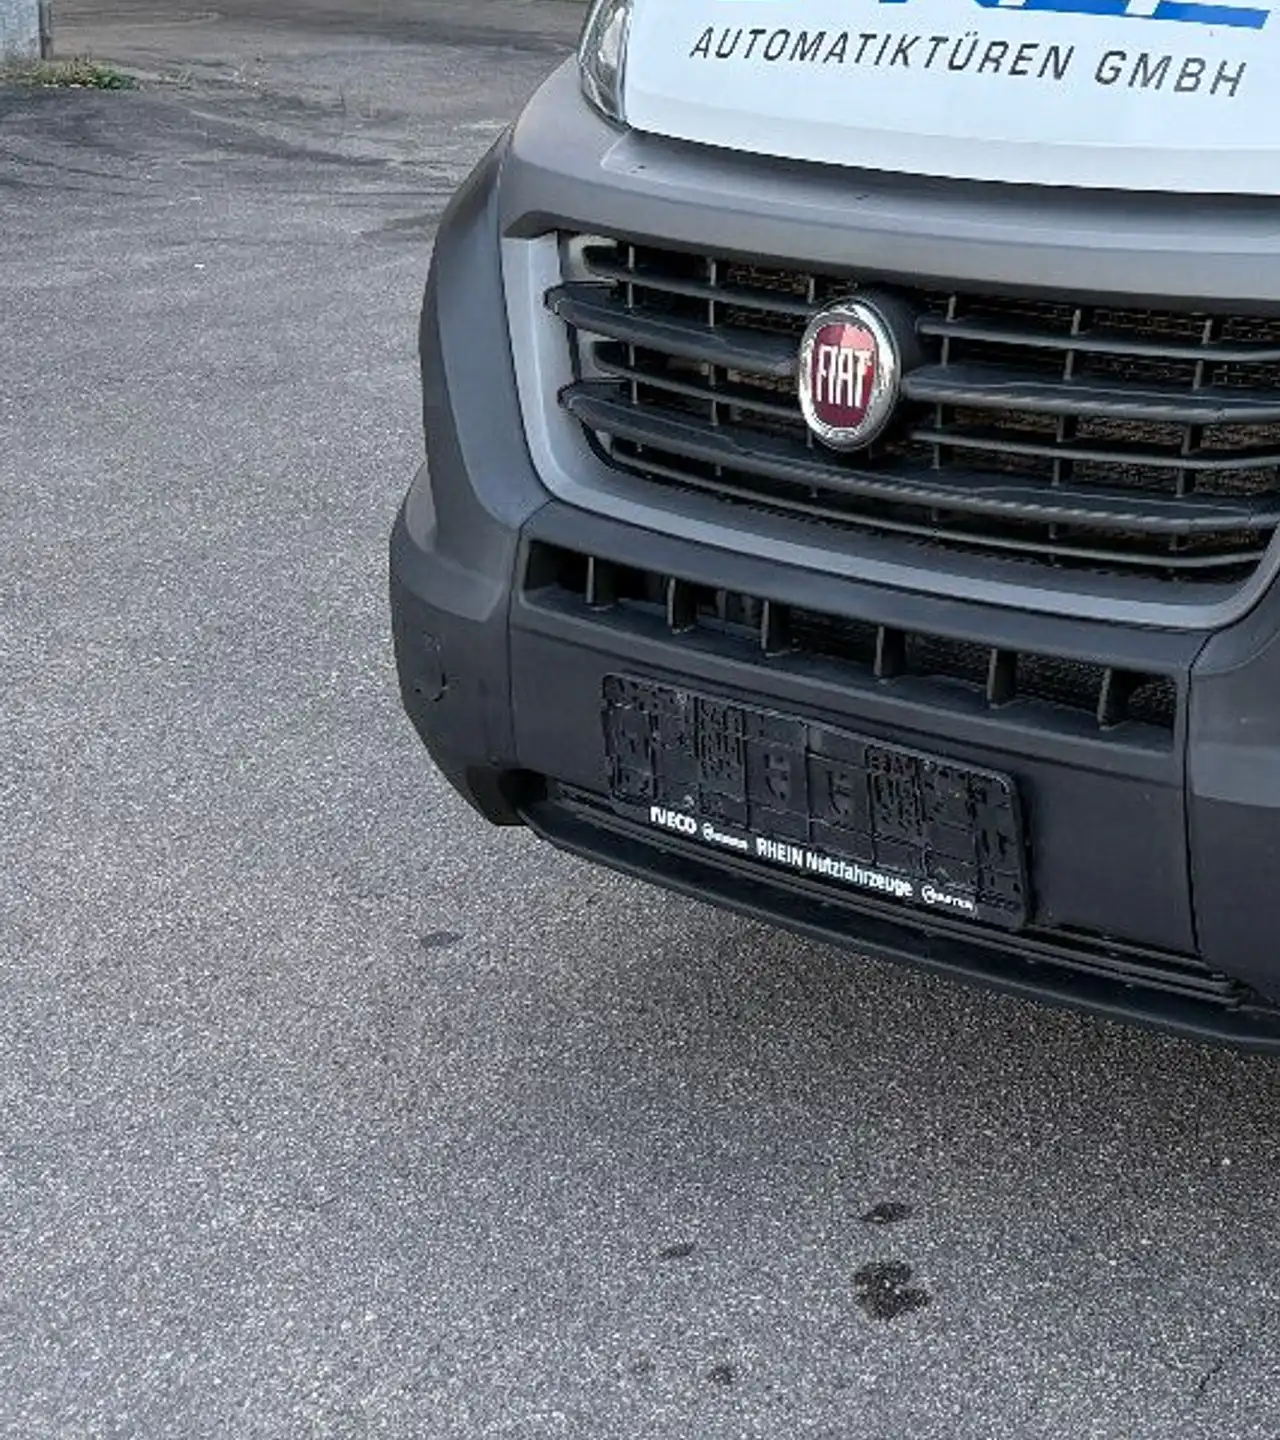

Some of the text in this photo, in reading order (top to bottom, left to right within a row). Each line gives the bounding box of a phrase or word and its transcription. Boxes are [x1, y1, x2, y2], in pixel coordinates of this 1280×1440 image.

[690, 26, 1248, 98] AUTOMATIKTÜREN GMBH
[815, 344, 875, 409] FIAT
[755, 837, 804, 868] RHEIN
[805, 851, 914, 897] Nutzfahrzeuge
